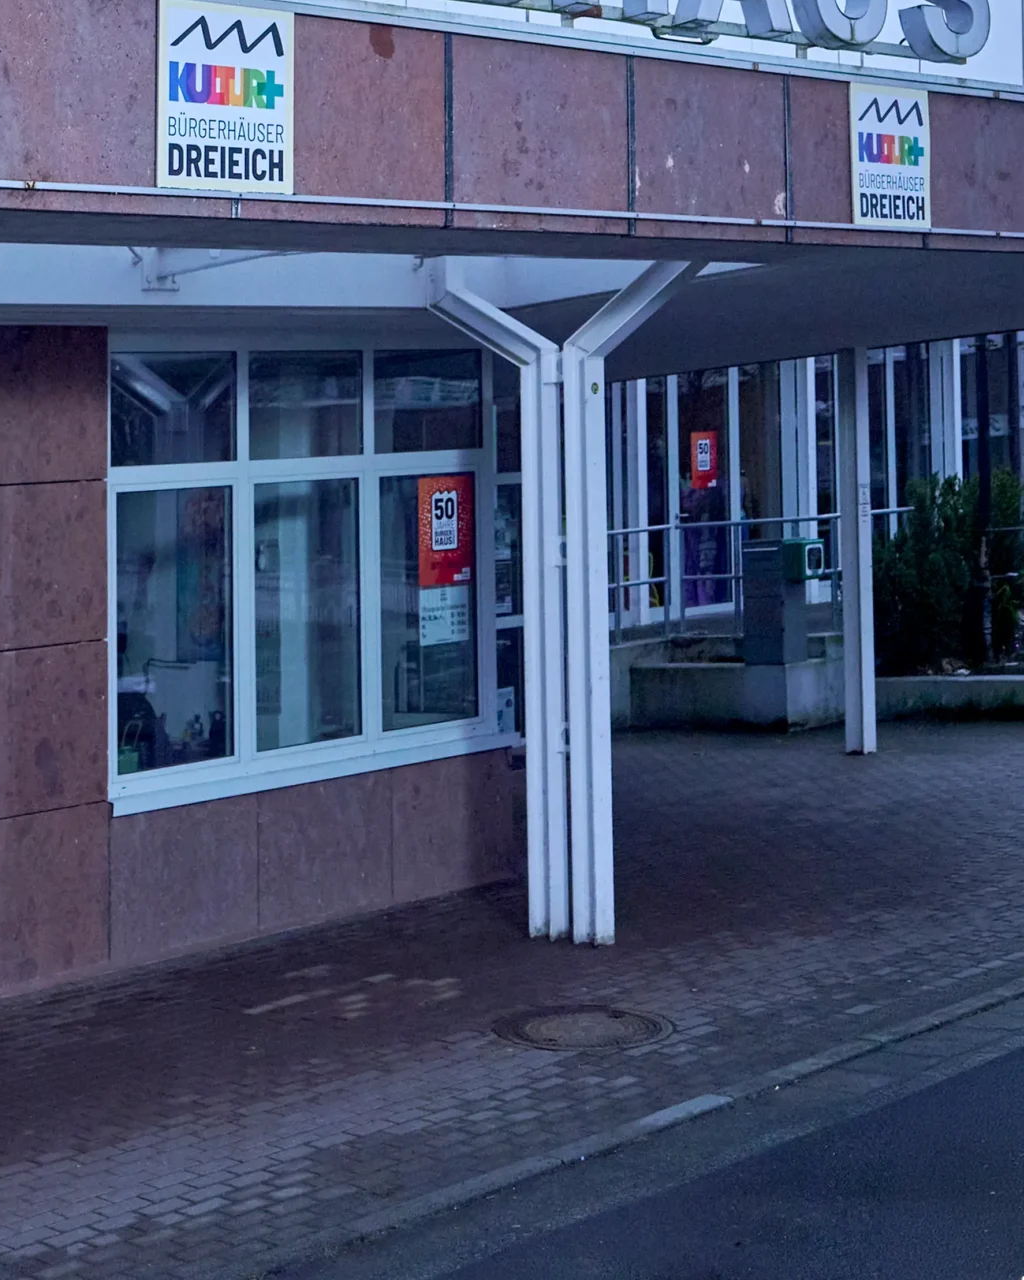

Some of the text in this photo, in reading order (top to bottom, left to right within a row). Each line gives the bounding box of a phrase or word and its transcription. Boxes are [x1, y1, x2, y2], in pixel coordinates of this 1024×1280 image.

[169, 61, 284, 109] KULTUR+
[168, 111, 285, 144] BÜRGERHÄUSER
[858, 132, 925, 166] KULTUR+
[168, 142, 284, 182] DREIEICH
[858, 170, 925, 192] BÜRGERHÄUSER
[860, 192, 925, 220] DREIEICH
[698, 443, 708, 454] 50
[434, 497, 454, 520] 50
[435, 520, 455, 529] JAHRE
[434, 536, 452, 546] HAUS
